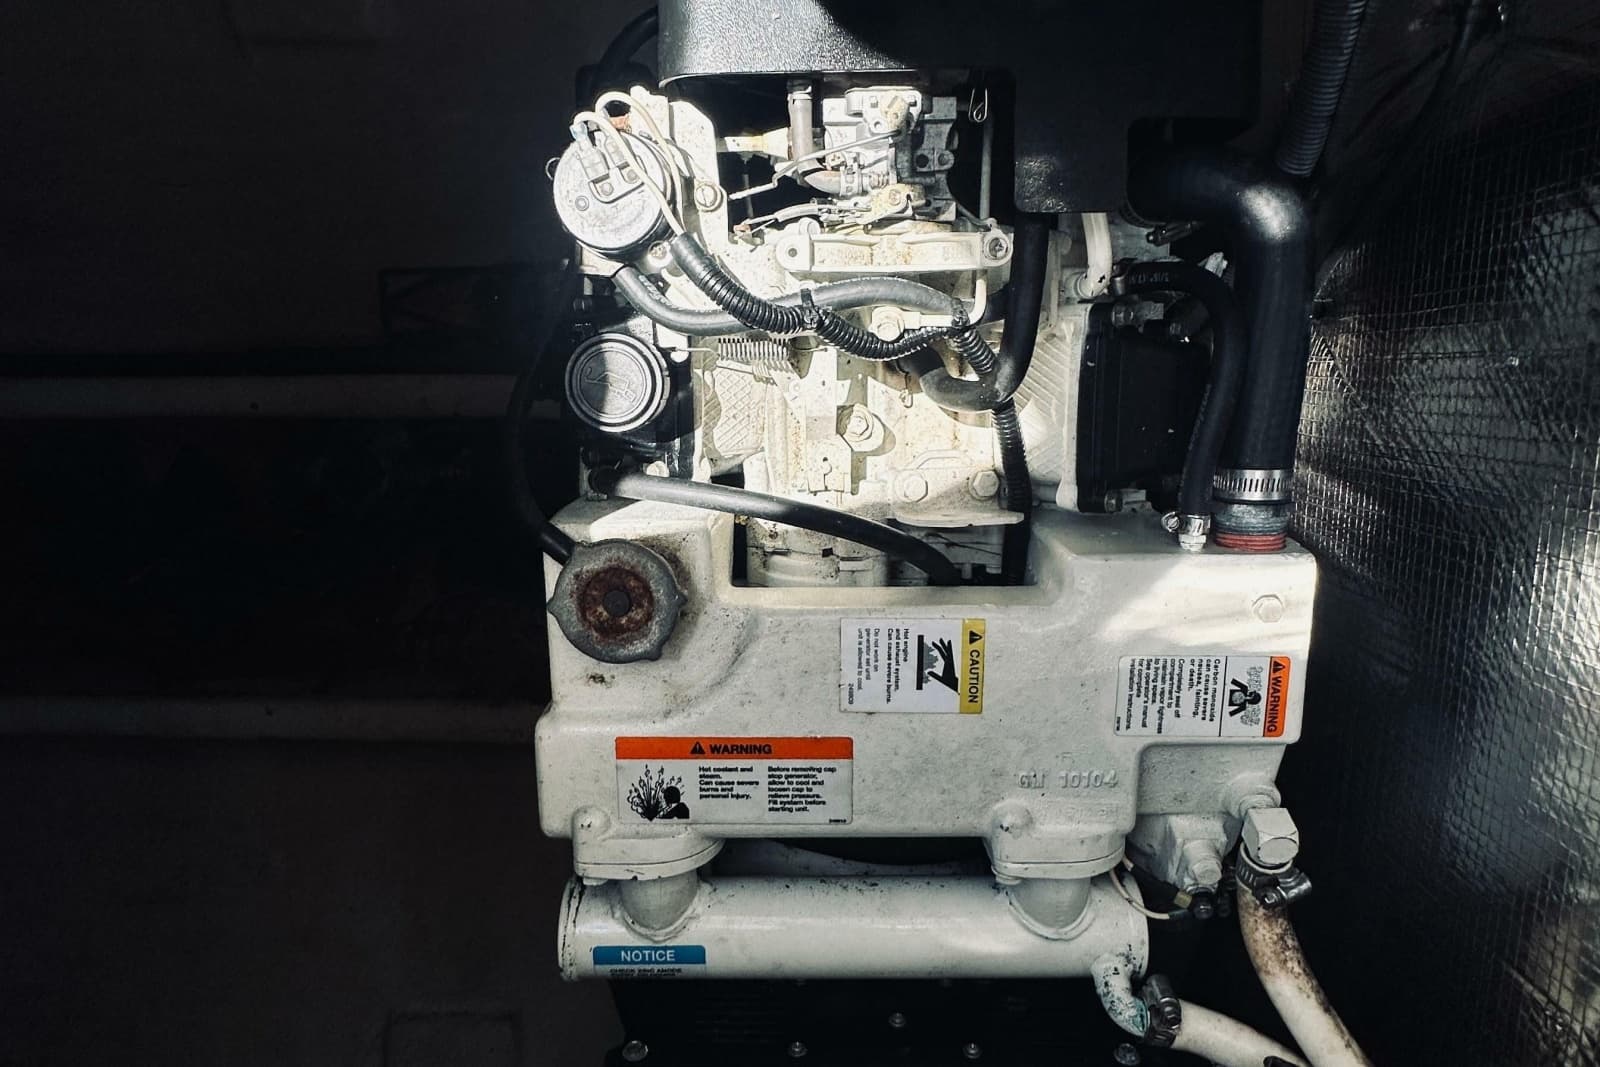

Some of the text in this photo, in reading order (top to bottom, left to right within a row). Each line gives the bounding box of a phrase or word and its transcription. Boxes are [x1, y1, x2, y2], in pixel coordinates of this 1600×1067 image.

[874, 628, 880, 636] Do
[968, 650, 980, 703] CAUTION
[1175, 659, 1185, 694] Completely
[1209, 688, 1217, 722] monoxide
[1267, 676, 1282, 733] WARNING
[710, 744, 772, 755] WARNING
[1058, 769, 1119, 789] 10104
[621, 950, 676, 961] NOTICE
